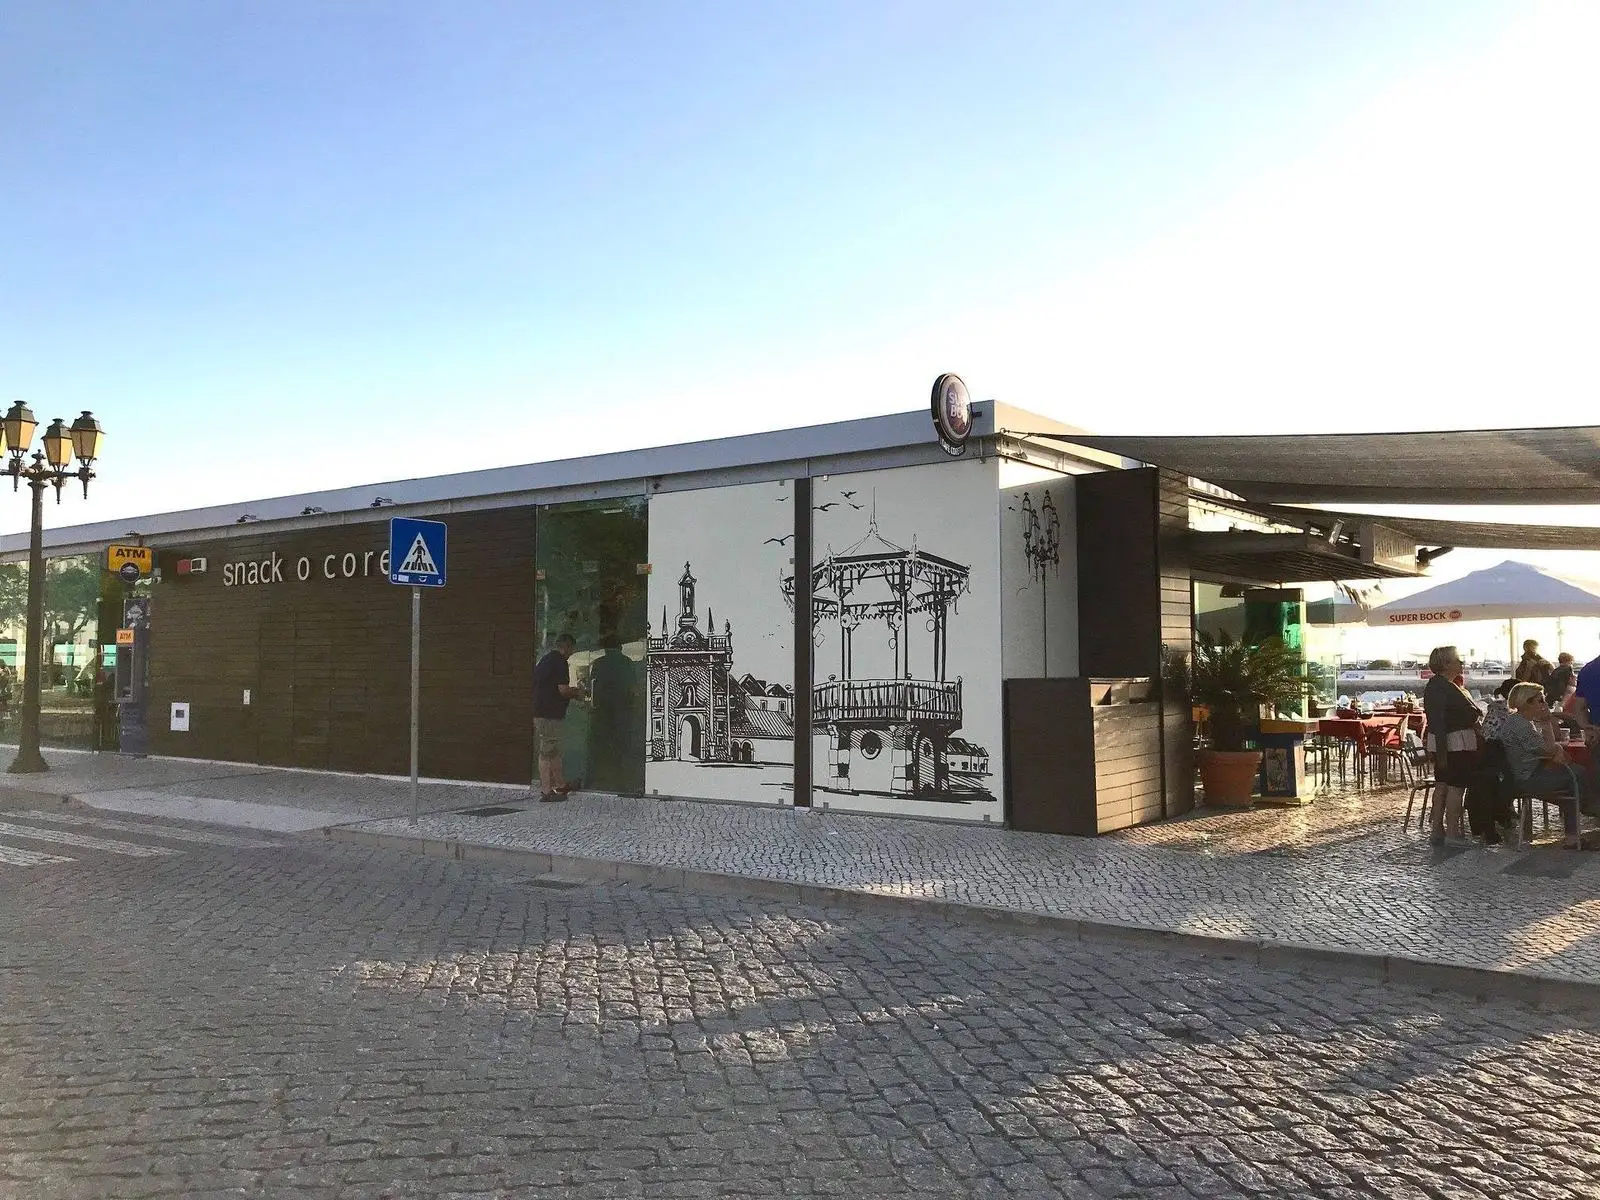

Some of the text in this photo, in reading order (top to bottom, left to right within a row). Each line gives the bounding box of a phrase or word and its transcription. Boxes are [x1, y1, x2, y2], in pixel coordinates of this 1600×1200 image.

[115, 548, 146, 559] ATM
[223, 551, 283, 587] snack
[297, 556, 310, 581] o
[1389, 613, 1418, 623] SUPER
[1420, 611, 1447, 621] BOCK
[119, 632, 132, 641] ATM
